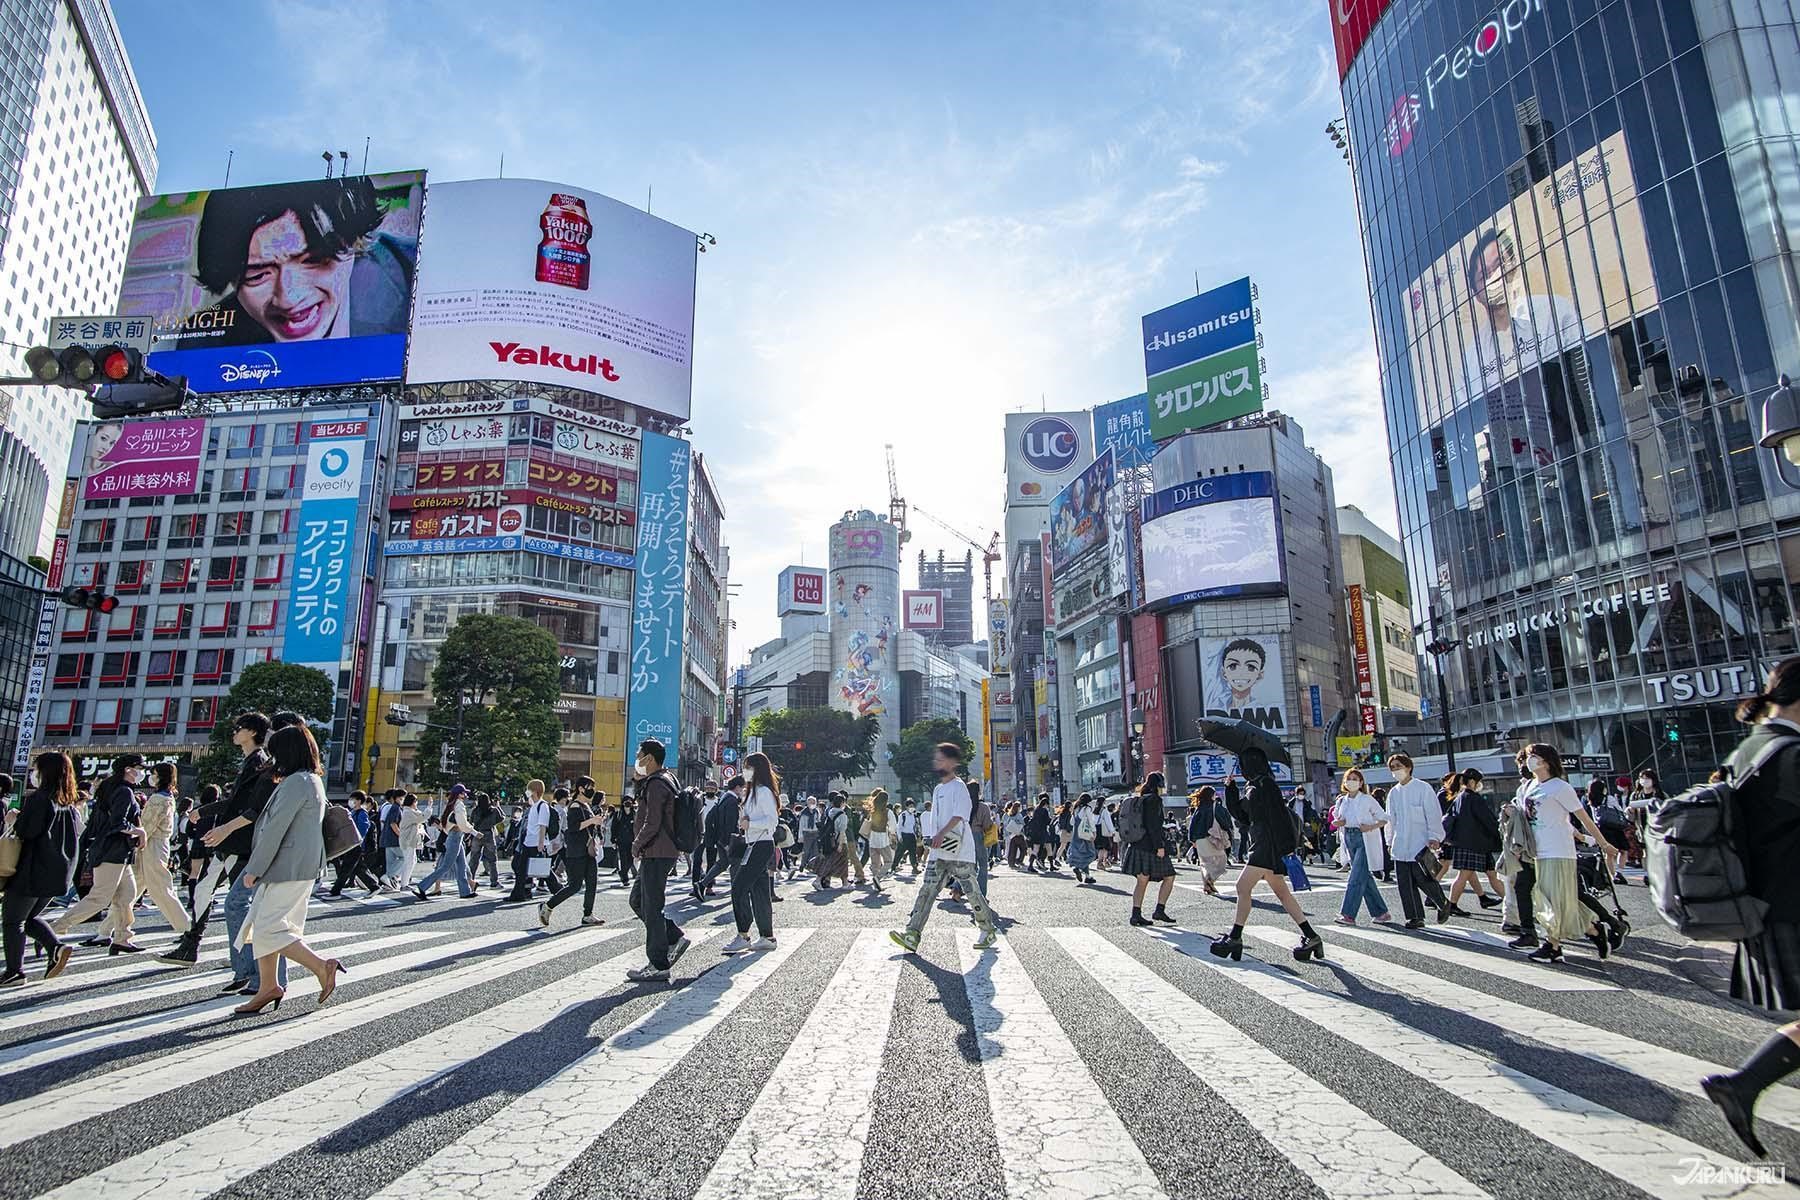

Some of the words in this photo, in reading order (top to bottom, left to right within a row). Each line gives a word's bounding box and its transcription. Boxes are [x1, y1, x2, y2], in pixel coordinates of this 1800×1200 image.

[545, 215, 589, 234] Yakult
[545, 226, 588, 245] 1000
[57, 320, 146, 341] 渋谷駅前
[1146, 307, 1251, 351] Hisamitsu
[489, 341, 620, 382] Yakult
[220, 363, 282, 384] Disney+
[1155, 366, 1253, 419] サロンパス
[413, 401, 505, 416] しゃぶしゃぶバイキング
[549, 404, 638, 435] しゃぶしゃぶバイキング
[1107, 411, 1145, 435] 龍角散
[141, 427, 199, 441] 品川スキン
[316, 424, 361, 436] 当ビル5F
[402, 431, 418, 442] 9F
[451, 421, 504, 441] しゃぶ葉
[140, 440, 191, 454] クリニック
[584, 432, 636, 460] しゃぶ葉
[101, 471, 191, 491] 品川美容外科
[418, 462, 502, 483] プライス
[529, 462, 614, 495] コンタクト
[310, 480, 354, 493] eyecity
[1174, 482, 1214, 505] DHC
[467, 491, 509, 508] ガスト
[415, 518, 438, 529] Café
[502, 519, 520, 527] ガスト
[588, 504, 628, 526] ガスト
[391, 520, 411, 534] 7F
[440, 515, 493, 537] ガスト
[389, 542, 414, 551] AEON
[422, 539, 499, 552] 英会話イーオン
[529, 540, 555, 550] AEON
[561, 544, 634, 566] 英会話イーオン
[660, 447, 687, 658] #そろそろデート
[295, 520, 328, 636] アイシティ
[319, 519, 349, 636] コンタクトの
[797, 577, 818, 587] UNI
[630, 492, 666, 694] 再開しませんか
[797, 589, 820, 601] QLO
[913, 602, 934, 616] H&M
[1466, 607, 1570, 650] STARBUCKS
[1583, 582, 1671, 619] COFFEE
[29, 680, 41, 694] 内科
[647, 723, 672, 734] pairs
